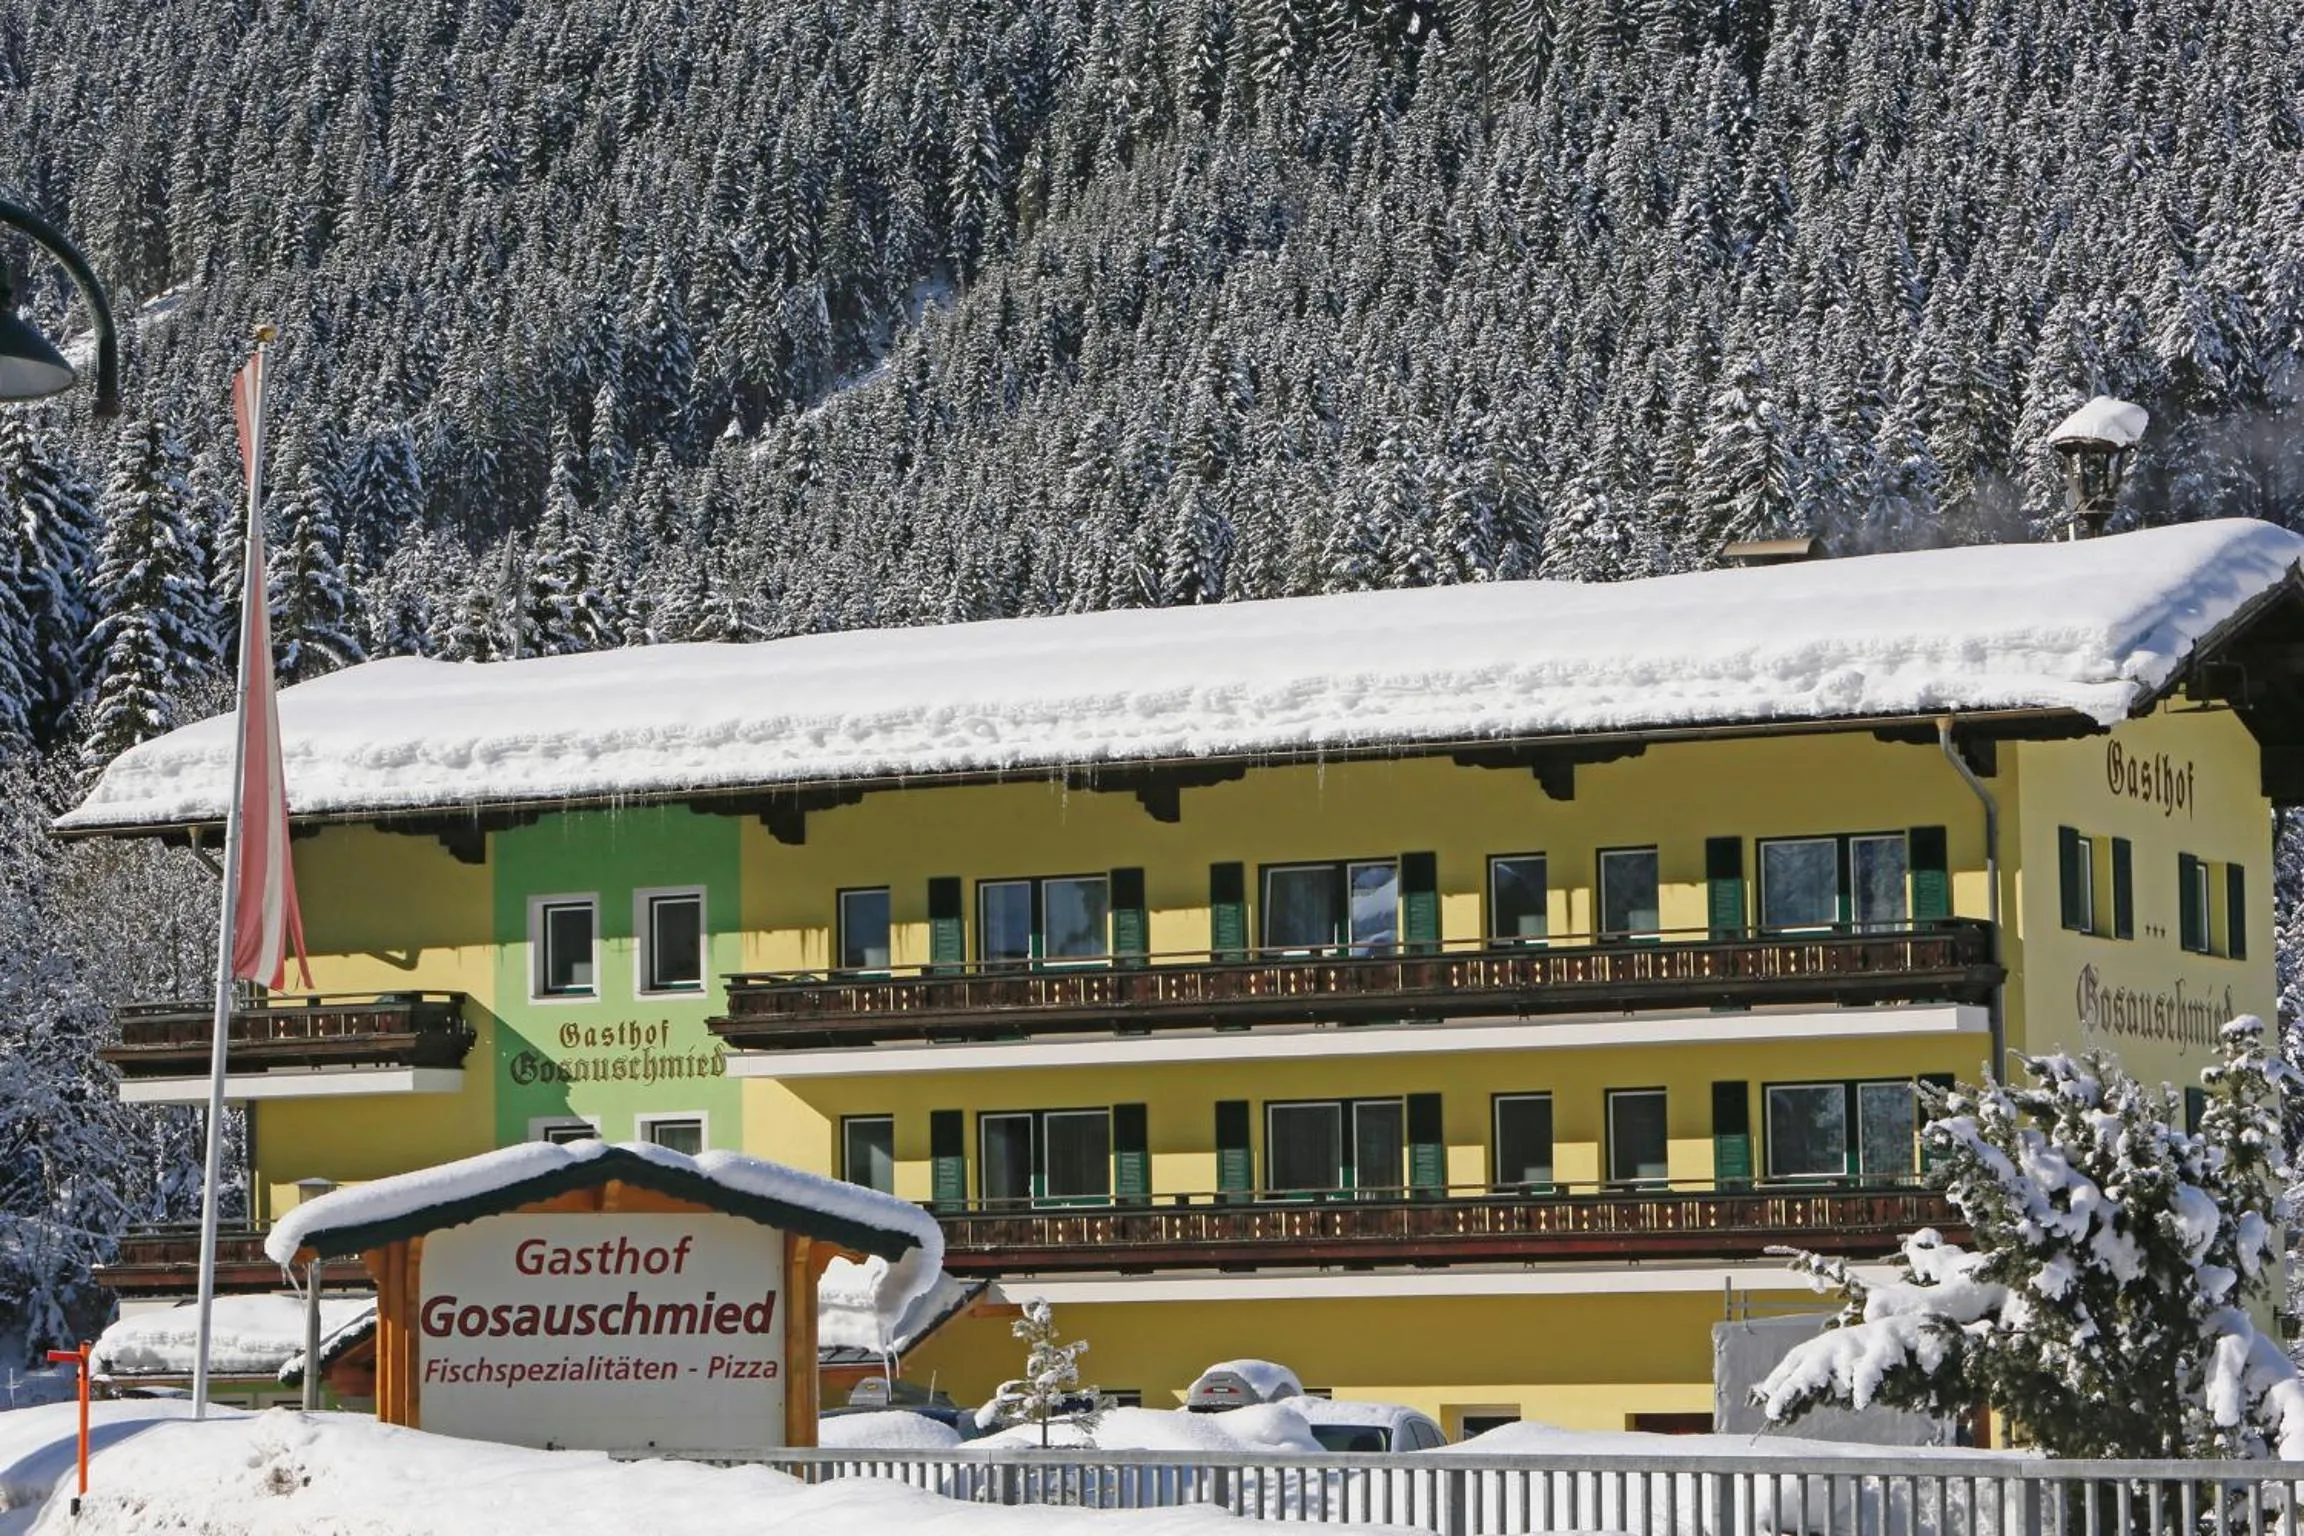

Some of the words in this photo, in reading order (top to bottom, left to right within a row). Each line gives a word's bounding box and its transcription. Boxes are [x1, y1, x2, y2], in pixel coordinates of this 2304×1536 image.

[2107, 738, 2194, 820] Gasthof
[559, 1019, 669, 1049] Gasthof
[510, 1042, 727, 1087] Gosauschmied
[515, 1236, 691, 1277] Gasthof
[421, 1291, 776, 1338] Gosauschmied
[424, 1357, 678, 1388] Fischspezialitäten
[707, 1355, 779, 1381] Pizza
